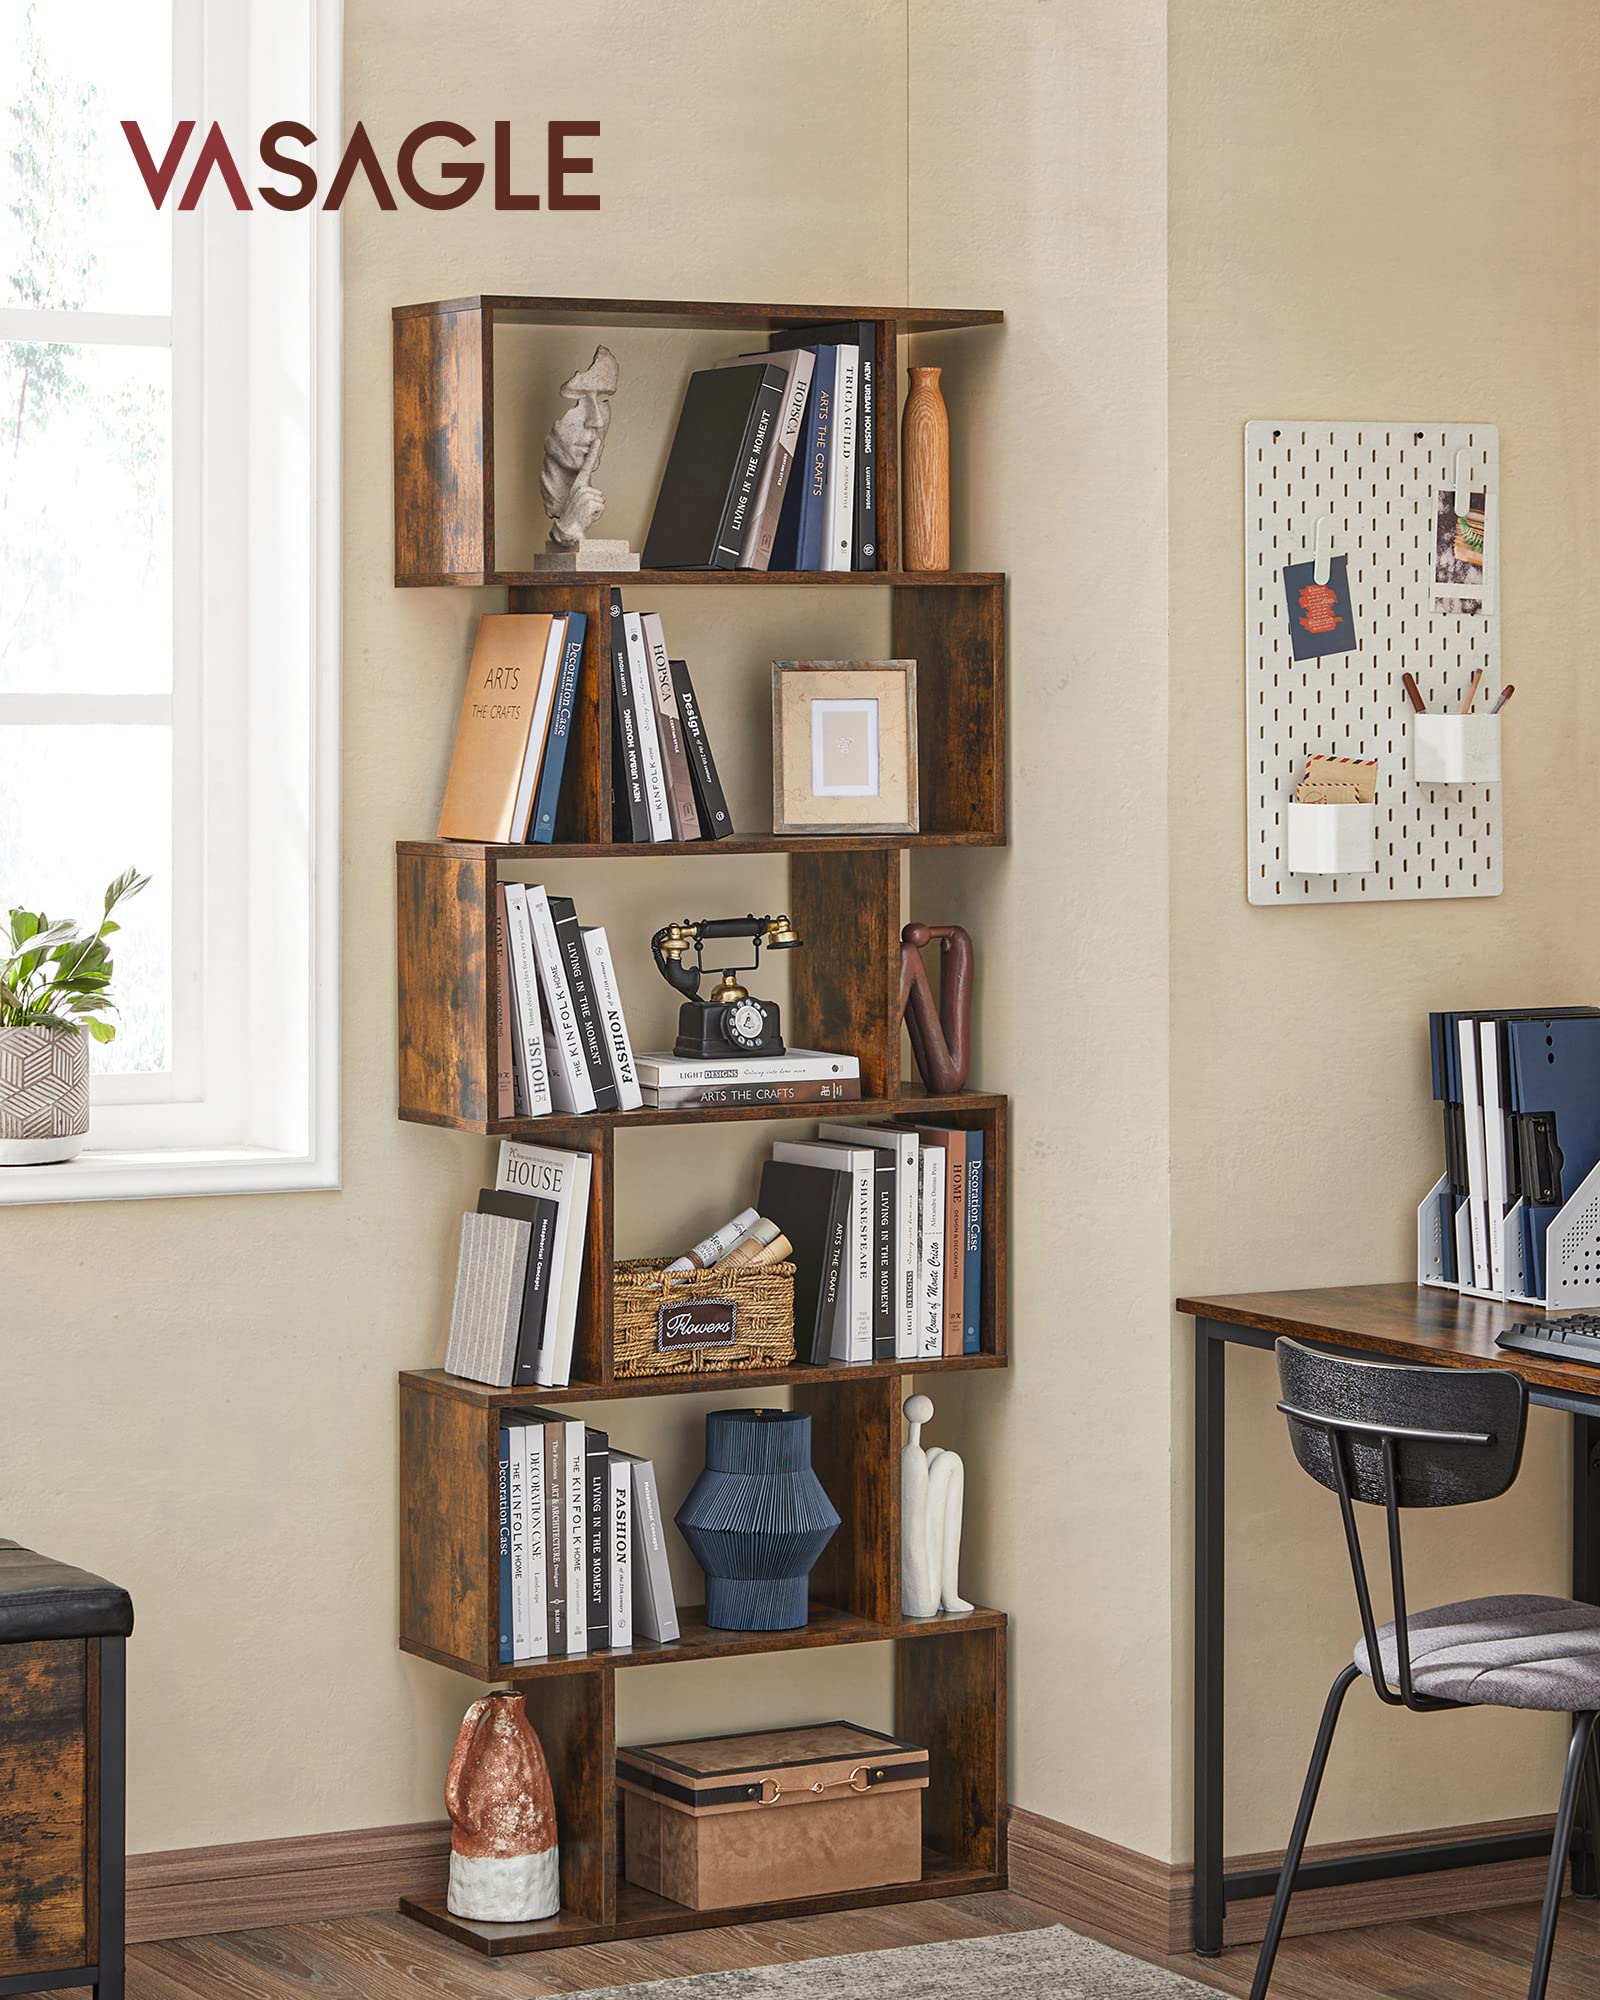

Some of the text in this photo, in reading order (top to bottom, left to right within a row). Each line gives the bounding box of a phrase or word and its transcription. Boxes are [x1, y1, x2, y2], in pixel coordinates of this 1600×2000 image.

[787, 380, 807, 436] HOPSCA
[843, 366, 854, 459] TRICIA GUILD
[732, 410, 770, 531] LIVING IN THE MOMENT
[813, 390, 829, 496] ARTS THE CRAFTS
[484, 667, 521, 691] ARTS
[563, 642, 581, 706] Decoration
[617, 653, 628, 696] LUXURY HOUSE
[653, 644, 672, 702] HOPSCA
[472, 704, 521, 720] THE CRAFTS
[558, 708, 571, 737] Case
[682, 692, 700, 738] Design
[624, 708, 642, 803] NEW URBAN HOUSING
[650, 764, 662, 810] KINFOLK
[550, 965, 583, 1078] THE KINFOLK HOME
[567, 942, 602, 1065] LIVING IN THE MOMENT
[528, 1036, 546, 1094] HOUSE
[608, 1010, 633, 1084] FASHION
[705, 1070, 738, 1079] DESIGNS
[701, 1088, 794, 1102] ARTS THE CRAFTS
[506, 1160, 563, 1192] HOUSE
[953, 1164, 962, 1204] HOME
[970, 1160, 982, 1251] Decoration Case
[534, 1218, 548, 1291] Metaphorical Concepts
[860, 1179, 868, 1280] SHAKESPEARE
[880, 1192, 889, 1315] LIVING IN THE MOMENT
[827, 1222, 843, 1303] ARTS THE CRAFTS
[666, 1313, 731, 1338] Flowers
[925, 1242, 941, 1351] The Count of Monte Cristo
[512, 1462, 520, 1479] THE
[531, 1452, 541, 1529] DECORATION
[551, 1483, 560, 1498] ART
[572, 1456, 580, 1473] THE
[500, 1460, 510, 1556] Decoration Case
[512, 1484, 523, 1552] KINFOLK
[552, 1505, 561, 1563] ARCHITECTURE
[572, 1478, 582, 1545] KINFOLK
[616, 1488, 626, 1564] FASHION
[514, 1555, 523, 1580] HOME
[532, 1530, 543, 1561] CASE
[592, 1476, 601, 1604] LIVING IN THE MOMENT
